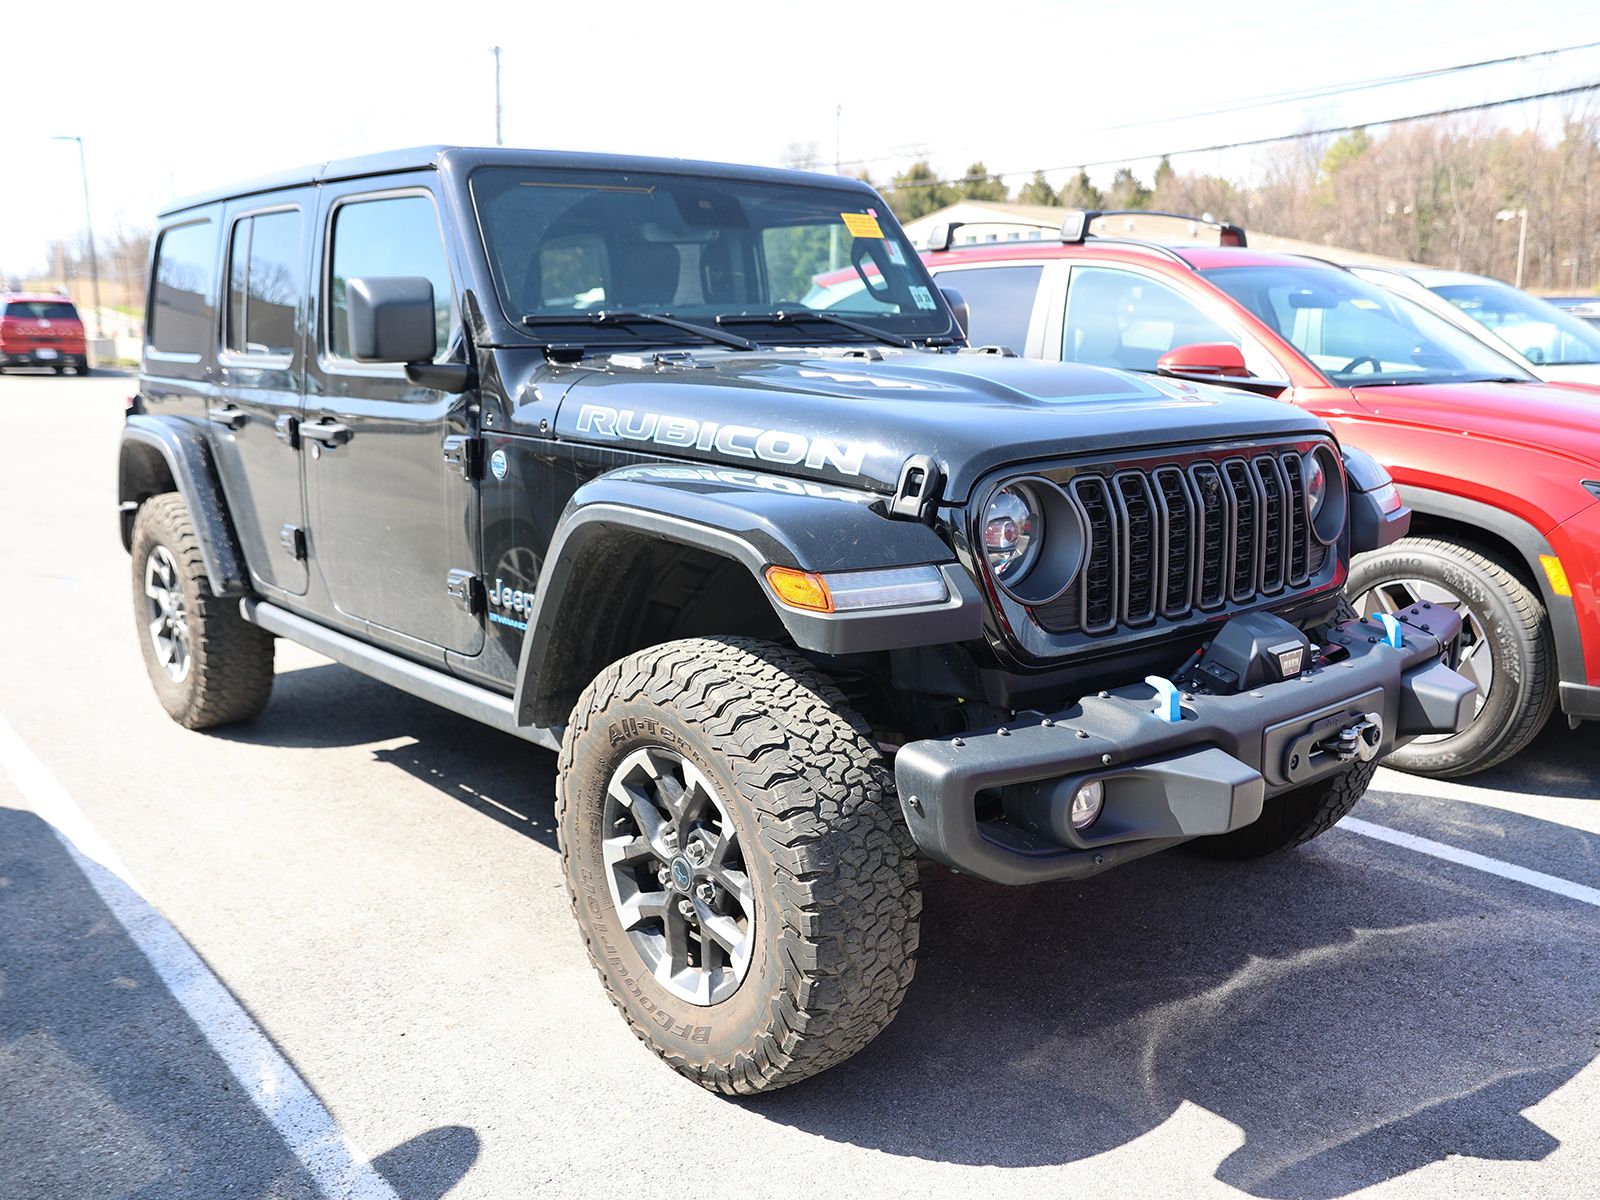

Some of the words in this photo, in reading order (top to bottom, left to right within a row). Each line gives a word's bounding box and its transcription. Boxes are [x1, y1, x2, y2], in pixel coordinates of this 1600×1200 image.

[576, 403, 870, 476] RUBICON
[1362, 557, 1422, 575] KUMHO
[489, 578, 534, 619] Jeep
